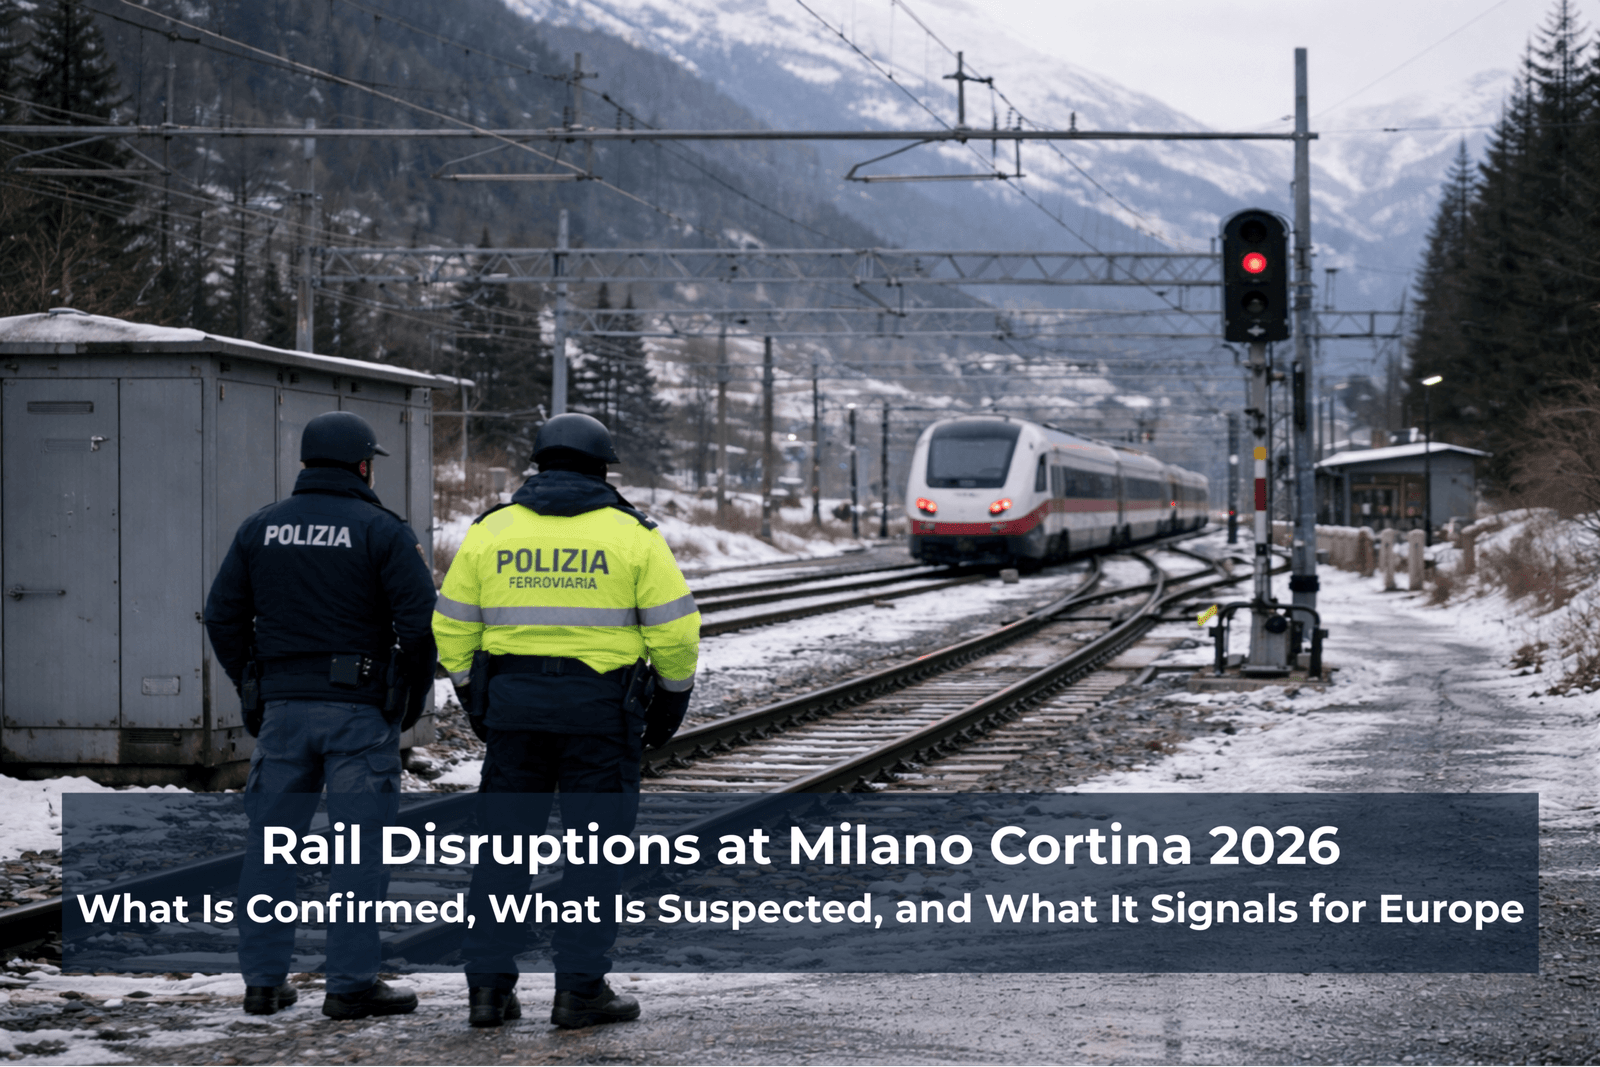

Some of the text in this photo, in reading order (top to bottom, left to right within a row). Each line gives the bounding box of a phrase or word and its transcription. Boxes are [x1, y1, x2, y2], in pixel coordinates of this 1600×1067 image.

[264, 524, 352, 548] POLIZIA
[497, 548, 609, 575] POLIZIA
[509, 576, 598, 590] FERROVIARIA
